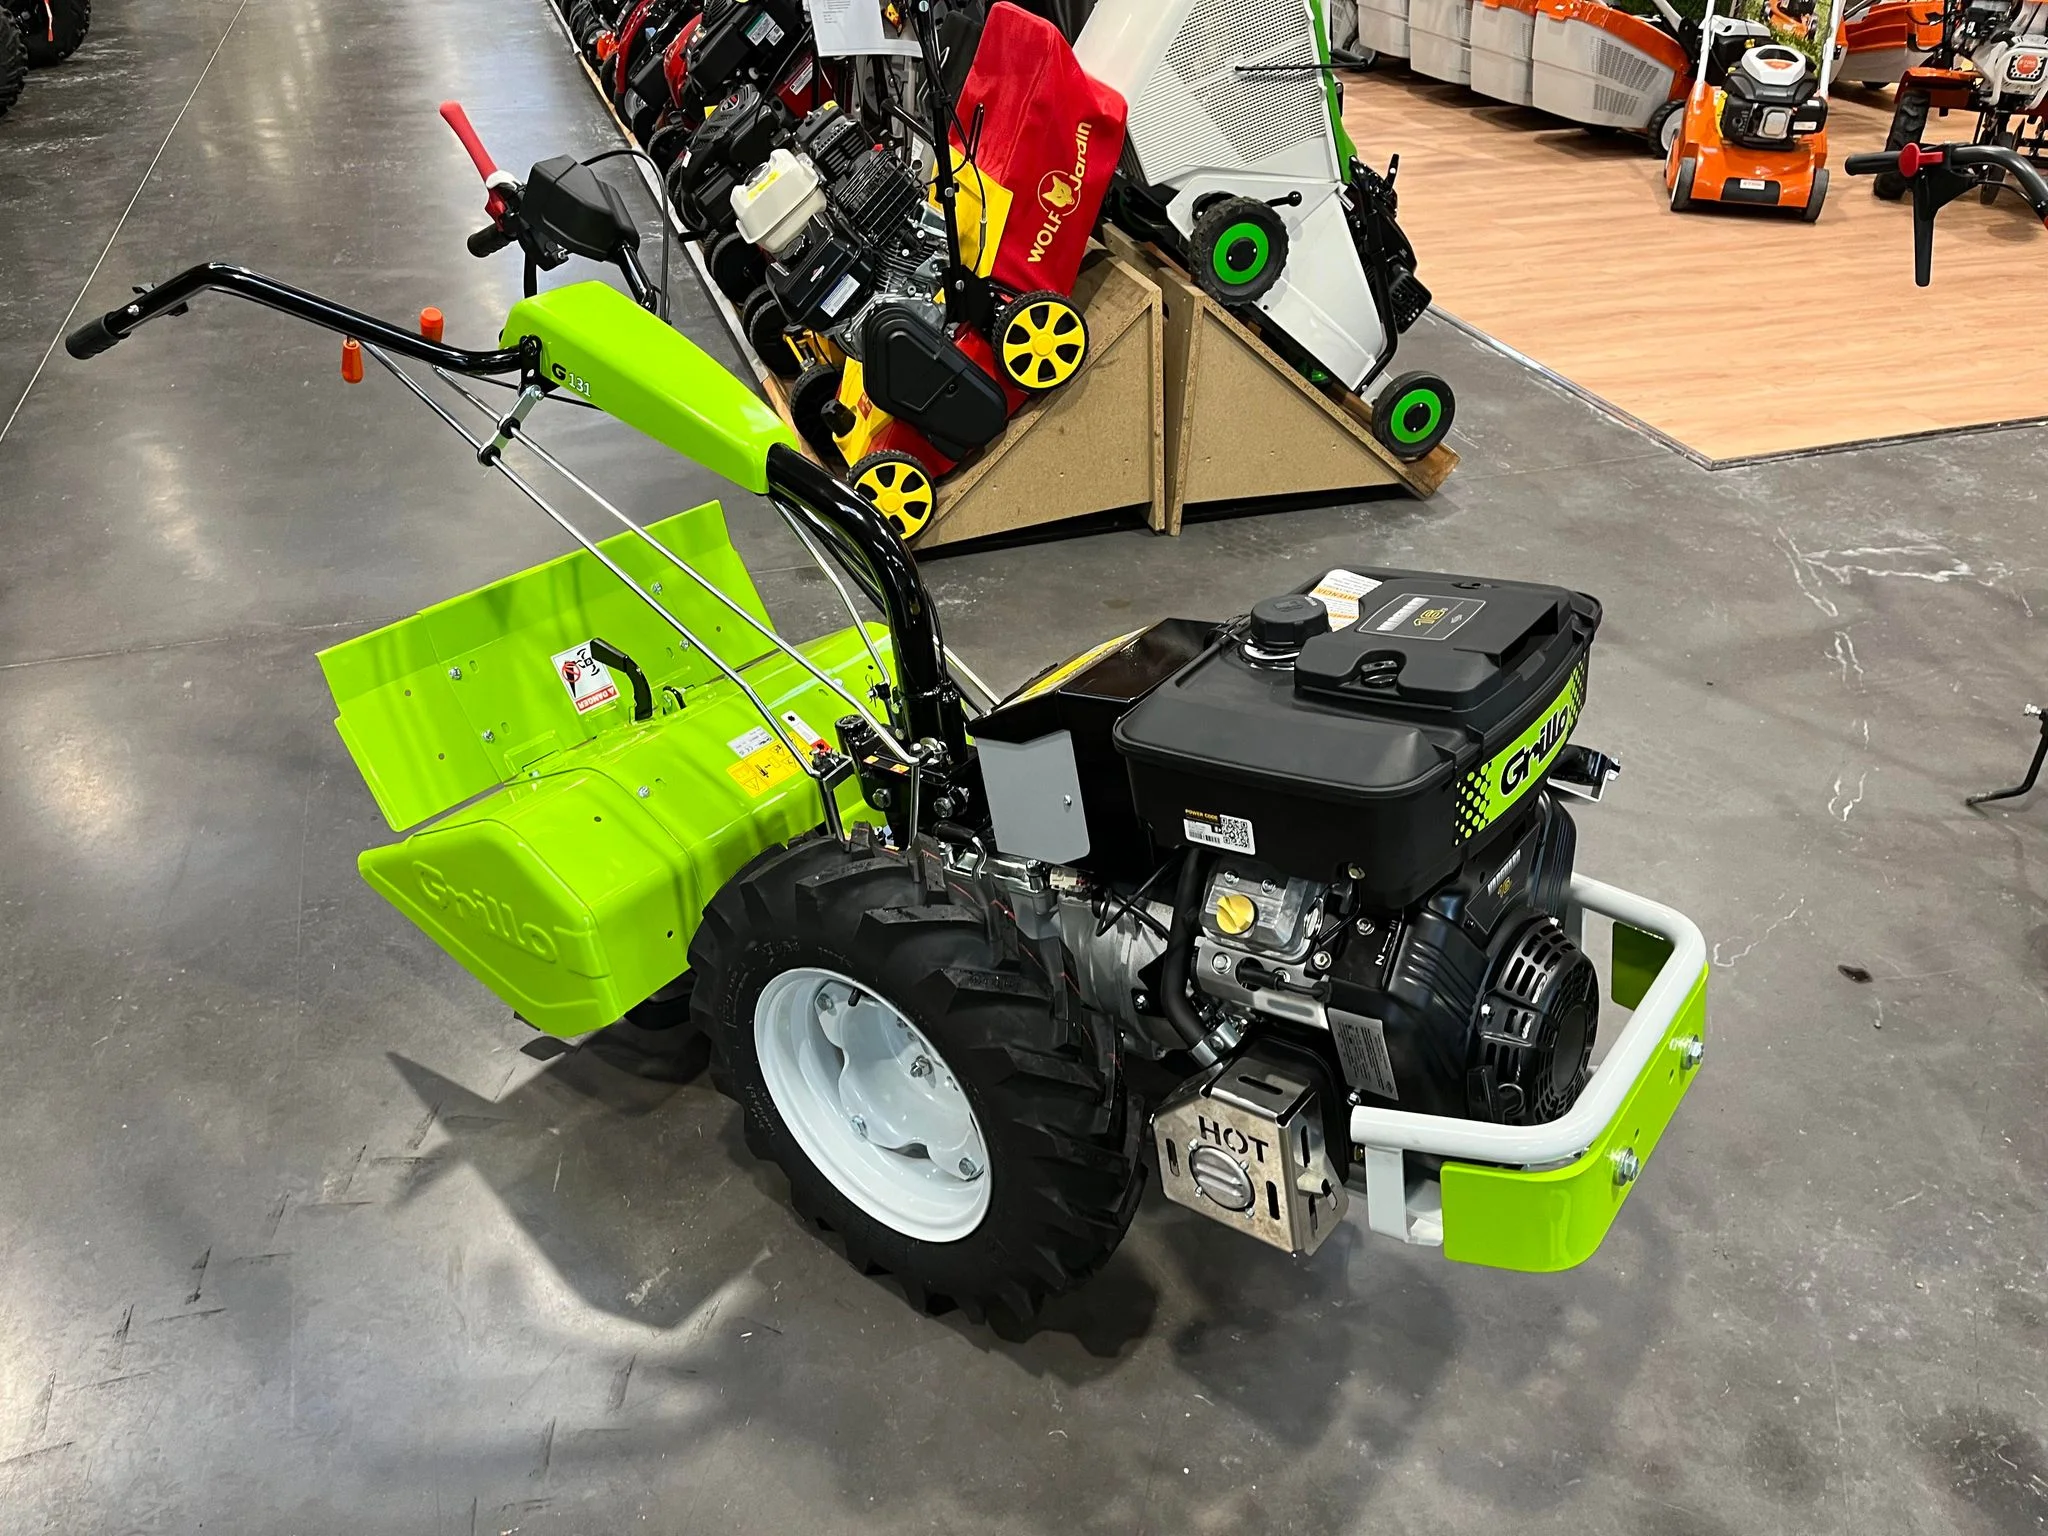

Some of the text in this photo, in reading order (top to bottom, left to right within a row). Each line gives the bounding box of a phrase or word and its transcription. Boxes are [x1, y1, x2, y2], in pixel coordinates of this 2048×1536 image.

[1027, 122, 1092, 263] WOLF Jardin
[551, 362, 591, 397] G 131
[577, 688, 608, 709] DANGER
[1500, 705, 1569, 796] Grillo
[1185, 808, 1218, 821] POWER CODE
[411, 859, 558, 964] Grillo
[1197, 1114, 1269, 1163] HOT
